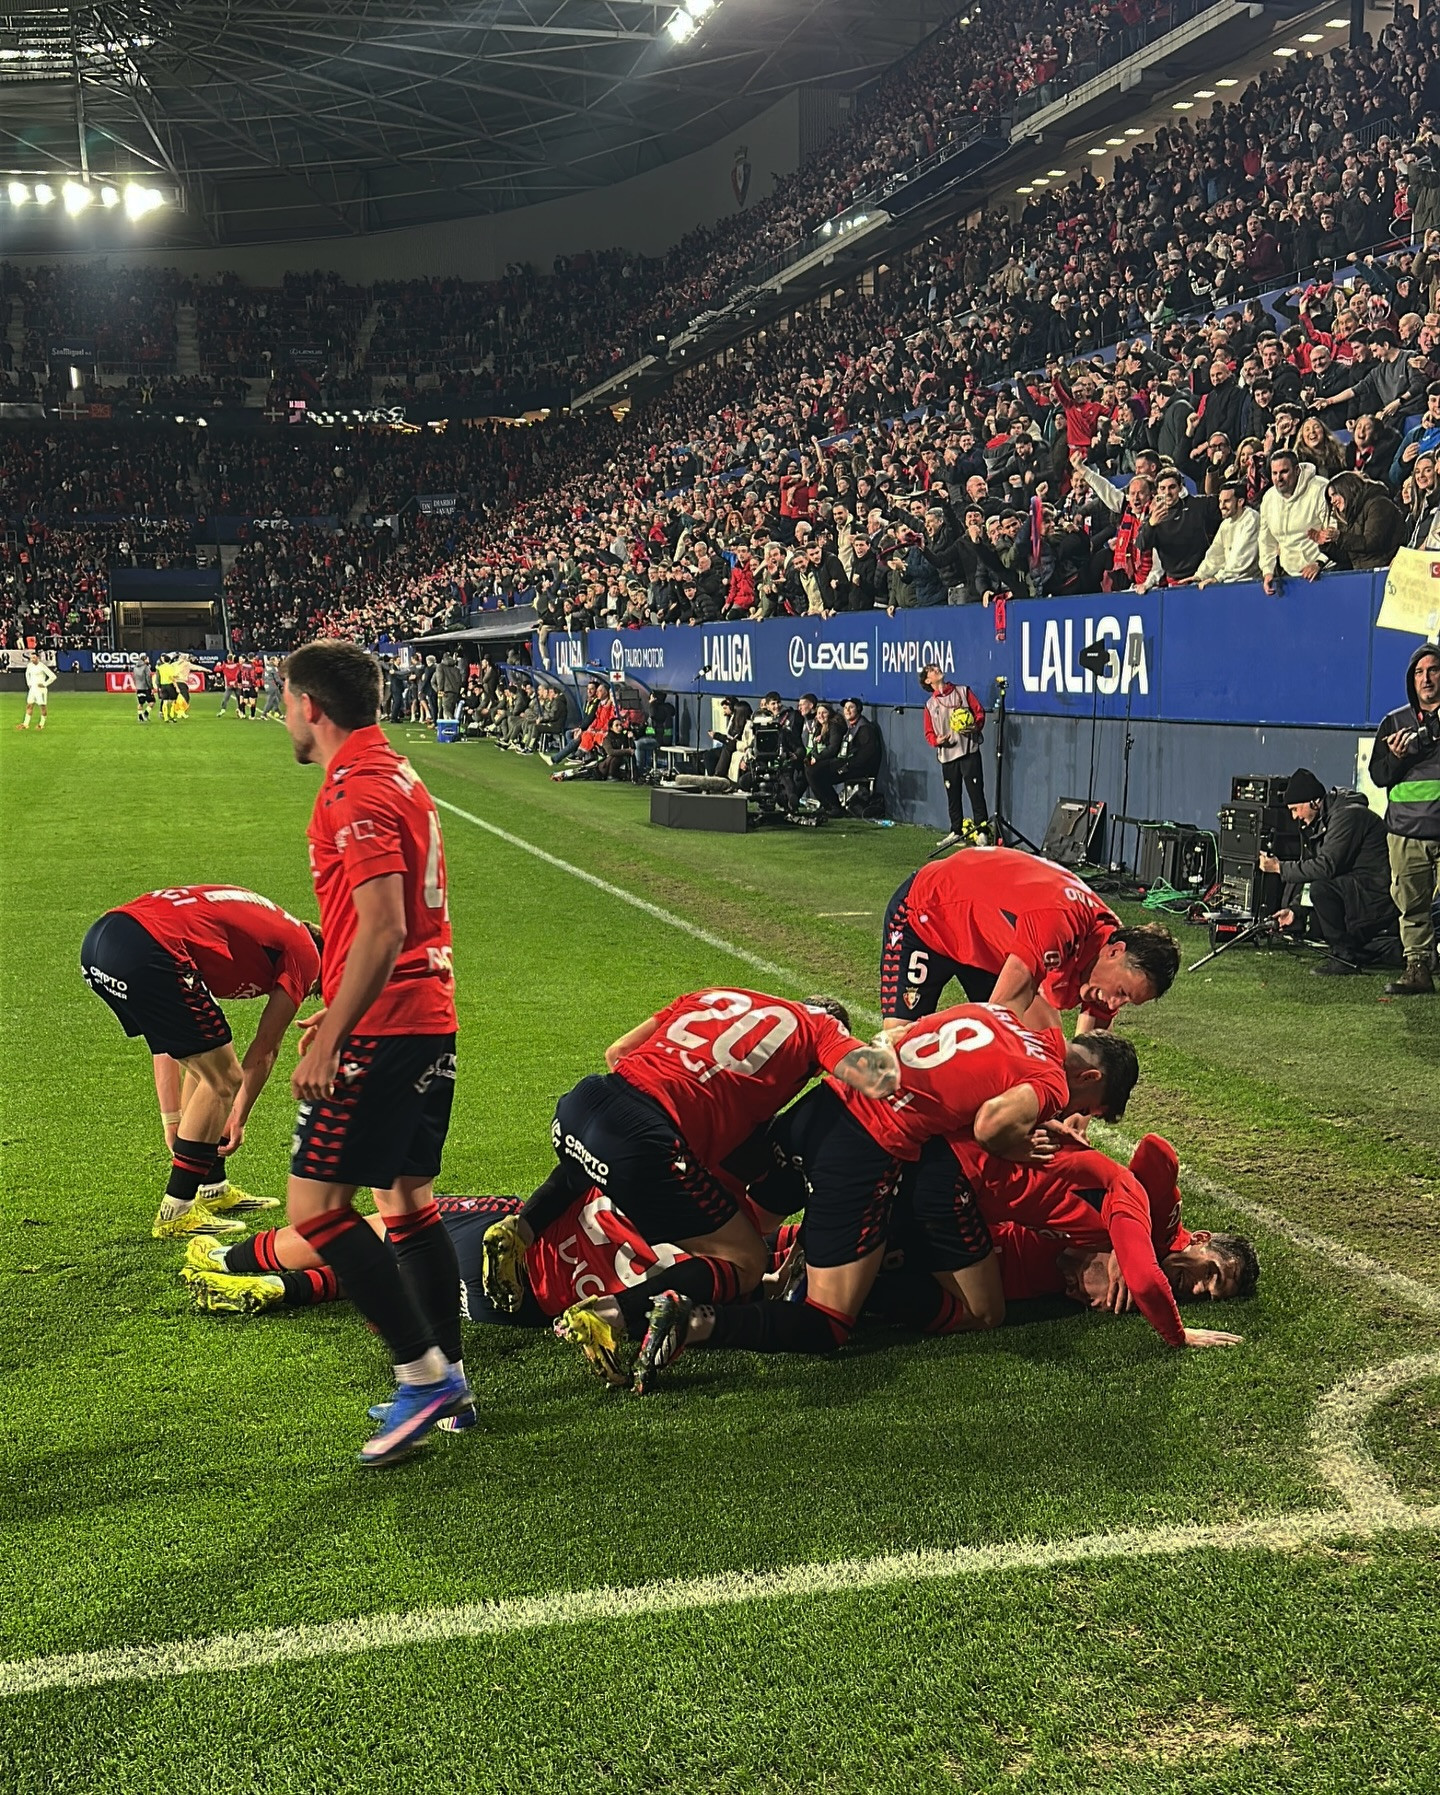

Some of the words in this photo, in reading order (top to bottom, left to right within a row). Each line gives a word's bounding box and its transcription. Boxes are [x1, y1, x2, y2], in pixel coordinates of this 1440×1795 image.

[624, 648, 641, 668] TAURO
[643, 647, 664, 668] MOTOR
[703, 633, 753, 682] LALIGA
[808, 641, 869, 670] LEXUS
[882, 640, 955, 674] PAMPLONA
[1022, 615, 1149, 695] LALIGA
[90, 966, 128, 992] CRYPTO
[907, 950, 929, 985] 5
[666, 990, 799, 1076] 20
[564, 1134, 609, 1176] CRYPTO
